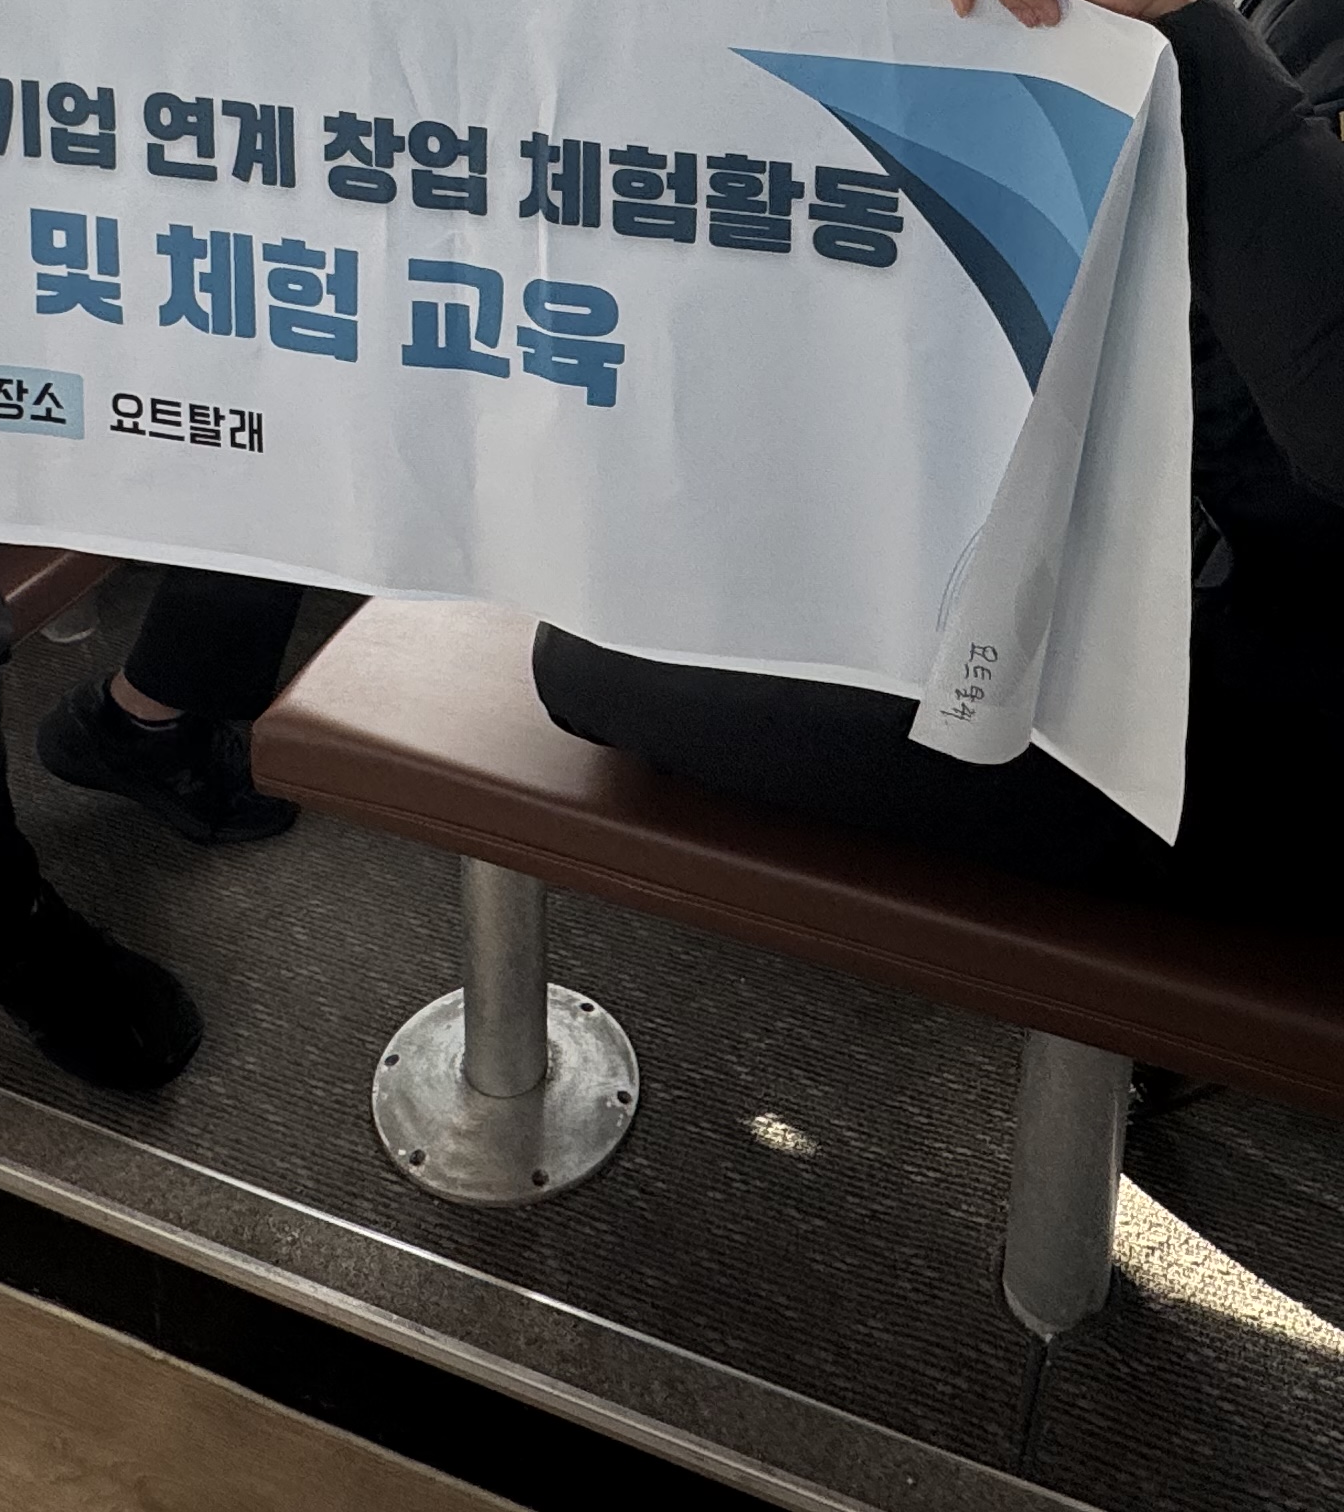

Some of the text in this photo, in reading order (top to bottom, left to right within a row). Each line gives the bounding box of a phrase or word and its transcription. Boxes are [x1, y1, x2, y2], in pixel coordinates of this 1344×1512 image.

[142, 91, 296, 188] 연계
[322, 110, 489, 216] 창업
[519, 131, 908, 270] 체험활동
[29, 207, 124, 326] 및
[156, 223, 359, 363] 체험
[401, 258, 626, 408] 교육
[109, 391, 265, 454] 요트탈래
